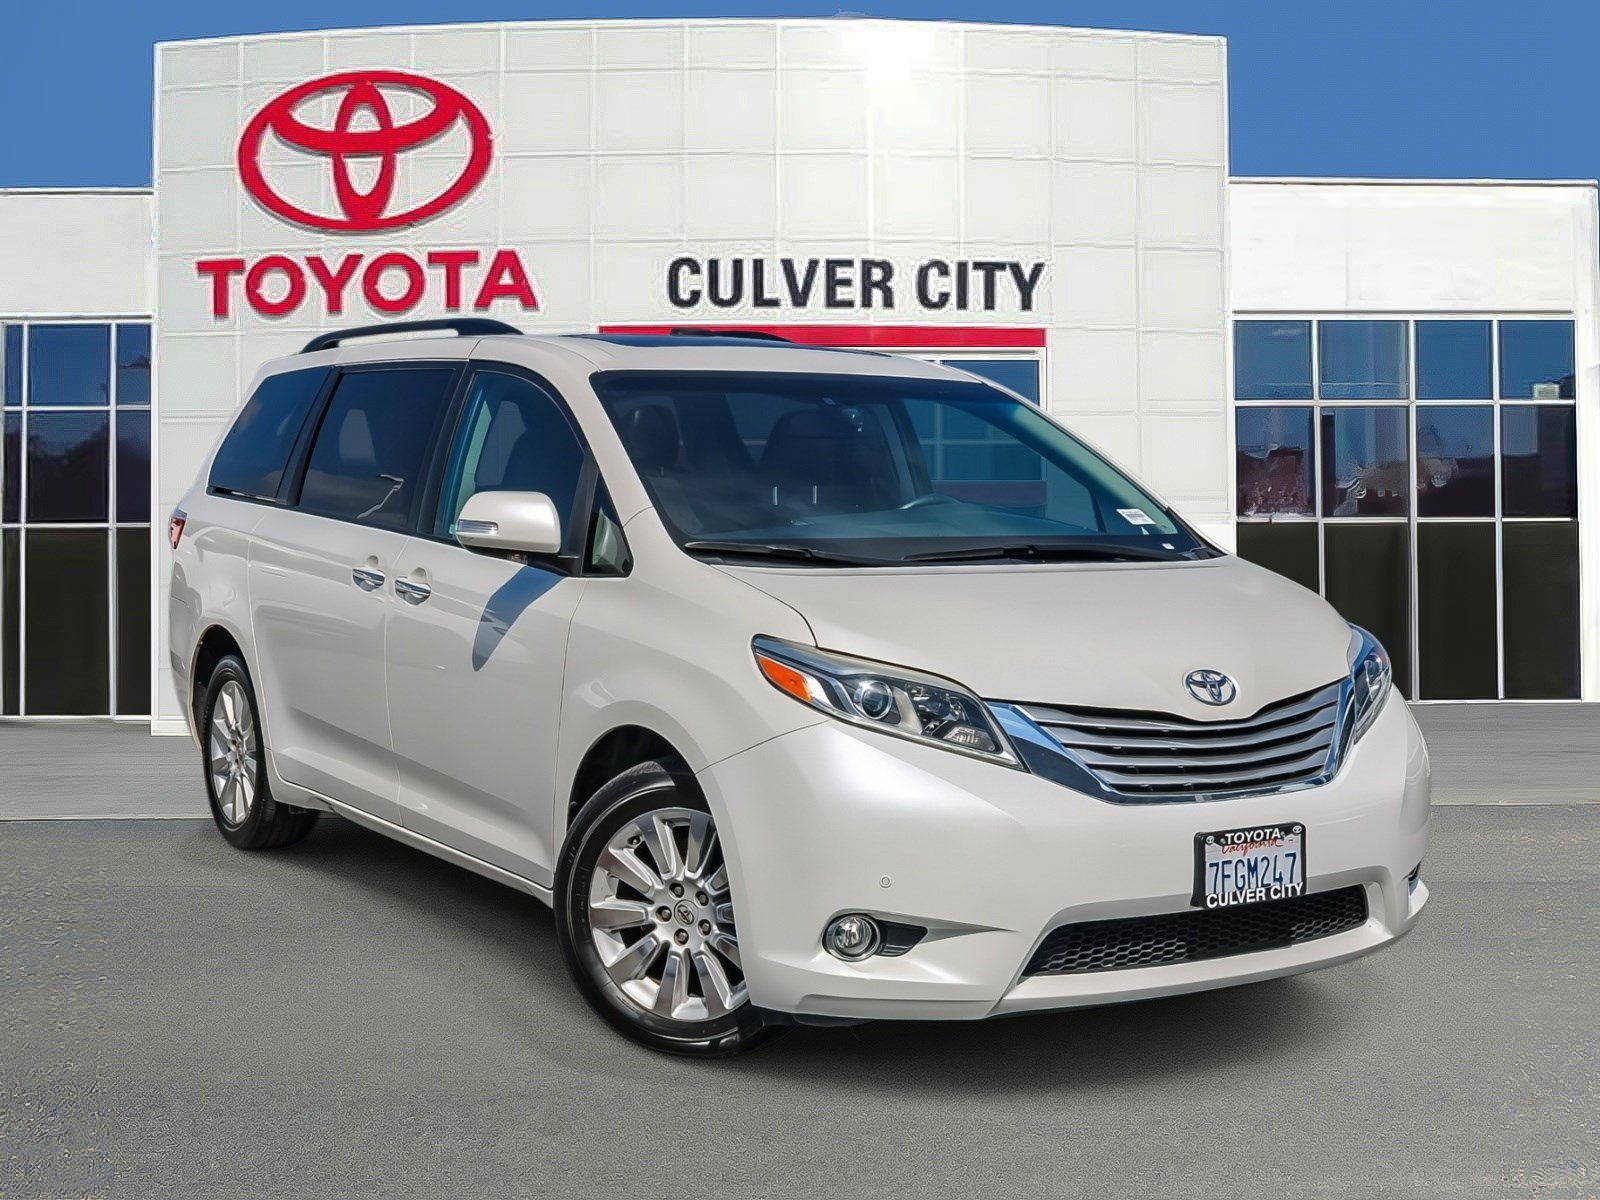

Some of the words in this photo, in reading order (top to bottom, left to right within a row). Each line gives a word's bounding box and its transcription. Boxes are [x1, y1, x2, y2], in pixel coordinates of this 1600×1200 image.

[197, 249, 538, 318] TOYOTA
[667, 257, 896, 309] CULVER
[915, 260, 1046, 312] CITY
[1225, 828, 1281, 845] TOYOTA
[1208, 852, 1297, 894] 7FGM247
[1206, 887, 1266, 908] CULVER
[1270, 882, 1304, 900] CITY
